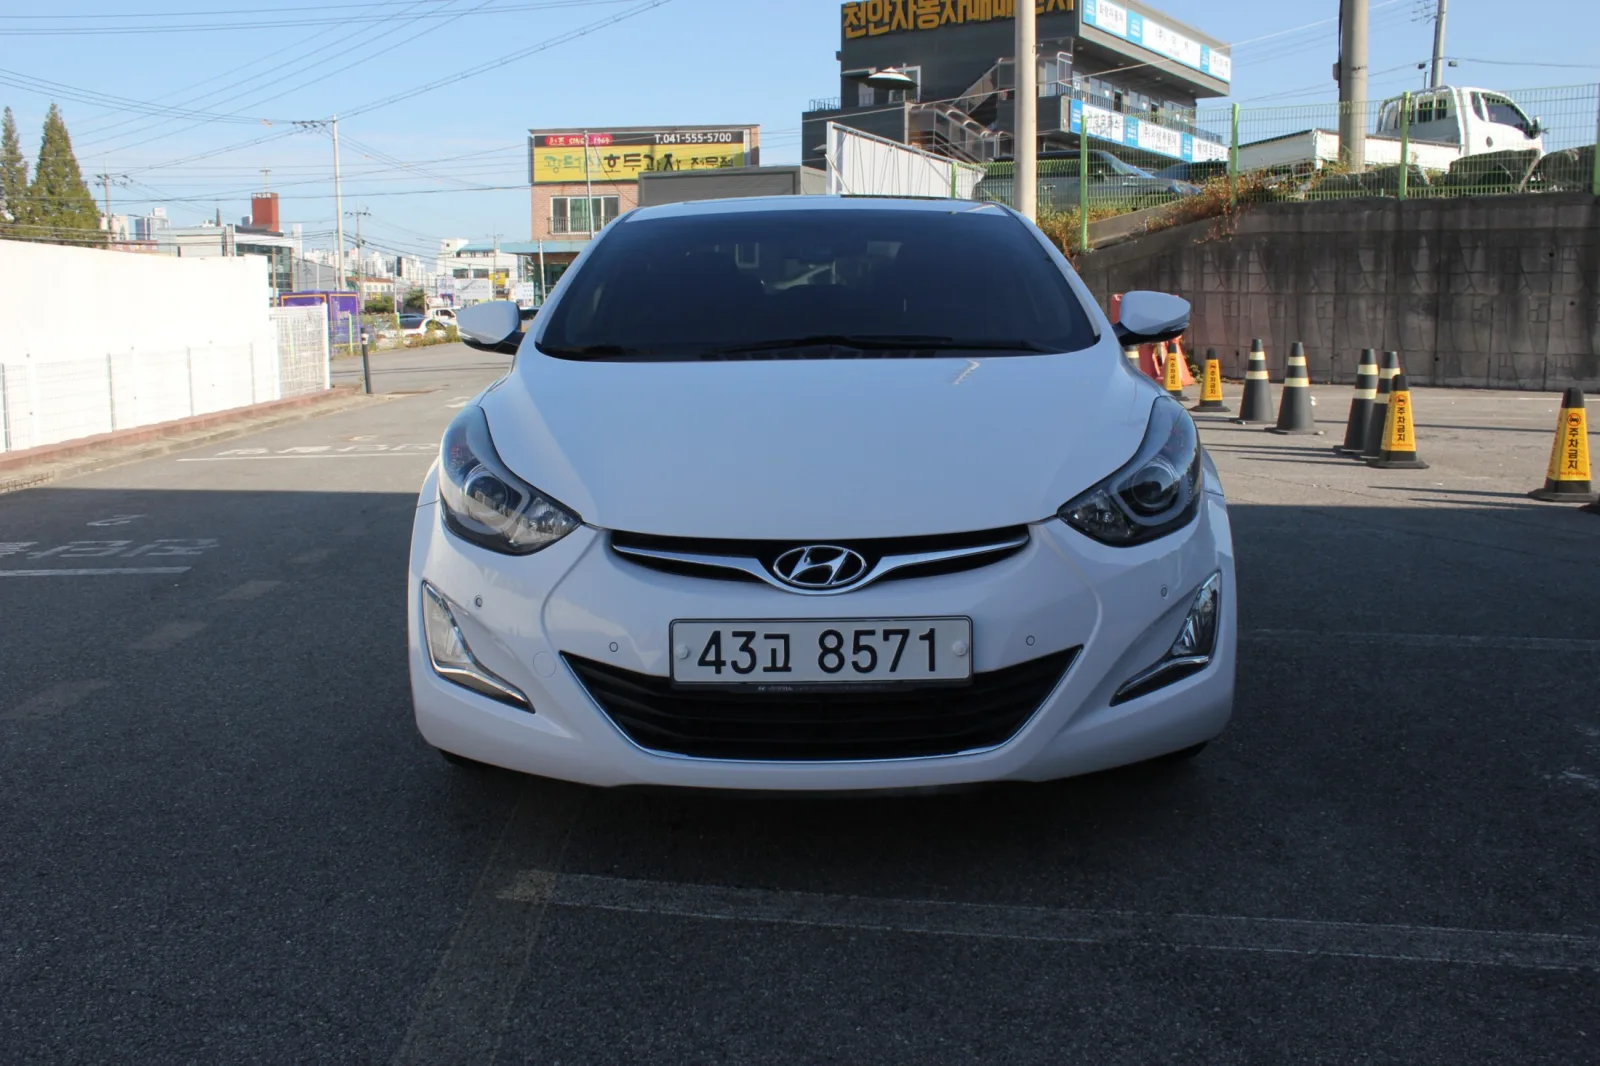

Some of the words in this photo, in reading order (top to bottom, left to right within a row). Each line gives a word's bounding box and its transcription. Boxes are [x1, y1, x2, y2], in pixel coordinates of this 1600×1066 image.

[843, 0, 1073, 39] 천안자동차매
[568, 136, 589, 145] SINC
[654, 133, 732, 144] T.041-555-5700
[603, 152, 682, 173] 호두과자
[1397, 407, 1406, 442] 주차금지
[1568, 428, 1579, 470] 주차금지
[697, 630, 792, 675] 43고
[817, 627, 936, 674] 8571
